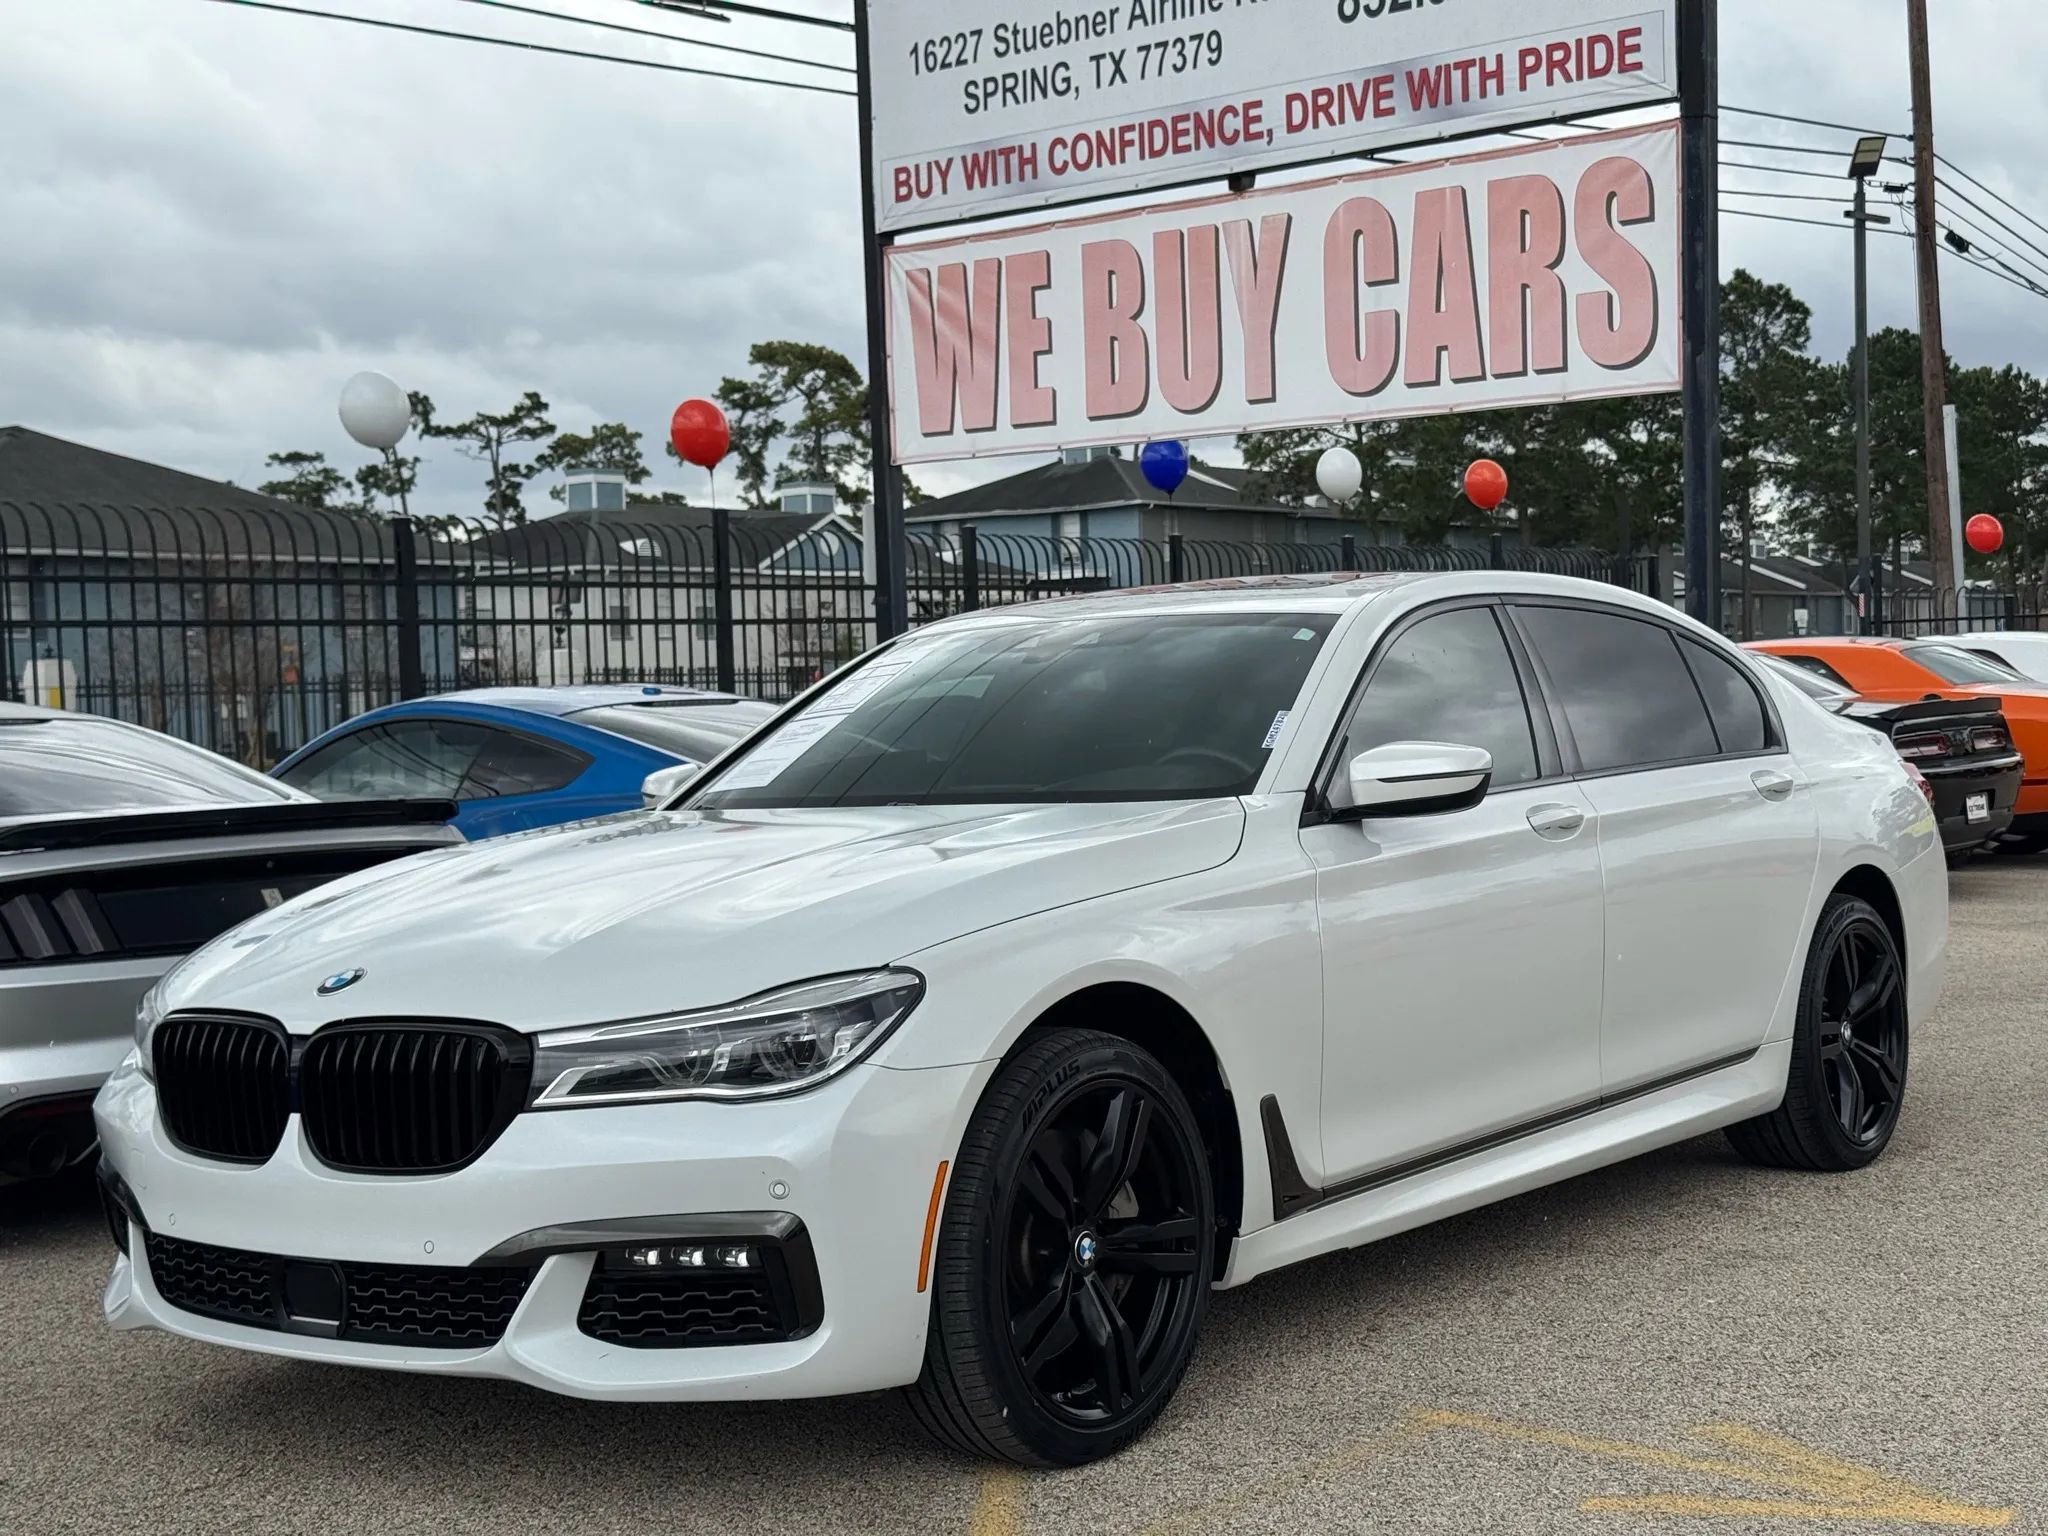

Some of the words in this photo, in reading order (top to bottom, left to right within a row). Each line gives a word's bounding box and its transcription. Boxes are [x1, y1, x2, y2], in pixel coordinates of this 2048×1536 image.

[909, 28, 983, 76] 16227
[993, 6, 1121, 58] Stuebner
[963, 61, 1080, 115] SPRING,
[1089, 49, 1128, 89] TX
[1136, 29, 1223, 80] 77379
[893, 158, 952, 202] BUY
[961, 146, 1038, 190] WITH
[1047, 98, 1275, 173] CONFIDENCE,
[1285, 74, 1396, 134] DRIVE
[1407, 52, 1505, 112] WITH
[1518, 26, 1645, 92] PRIDE
[906, 249, 1057, 436] WE
[1081, 211, 1293, 421] BUY
[1323, 155, 1660, 398] CARS
